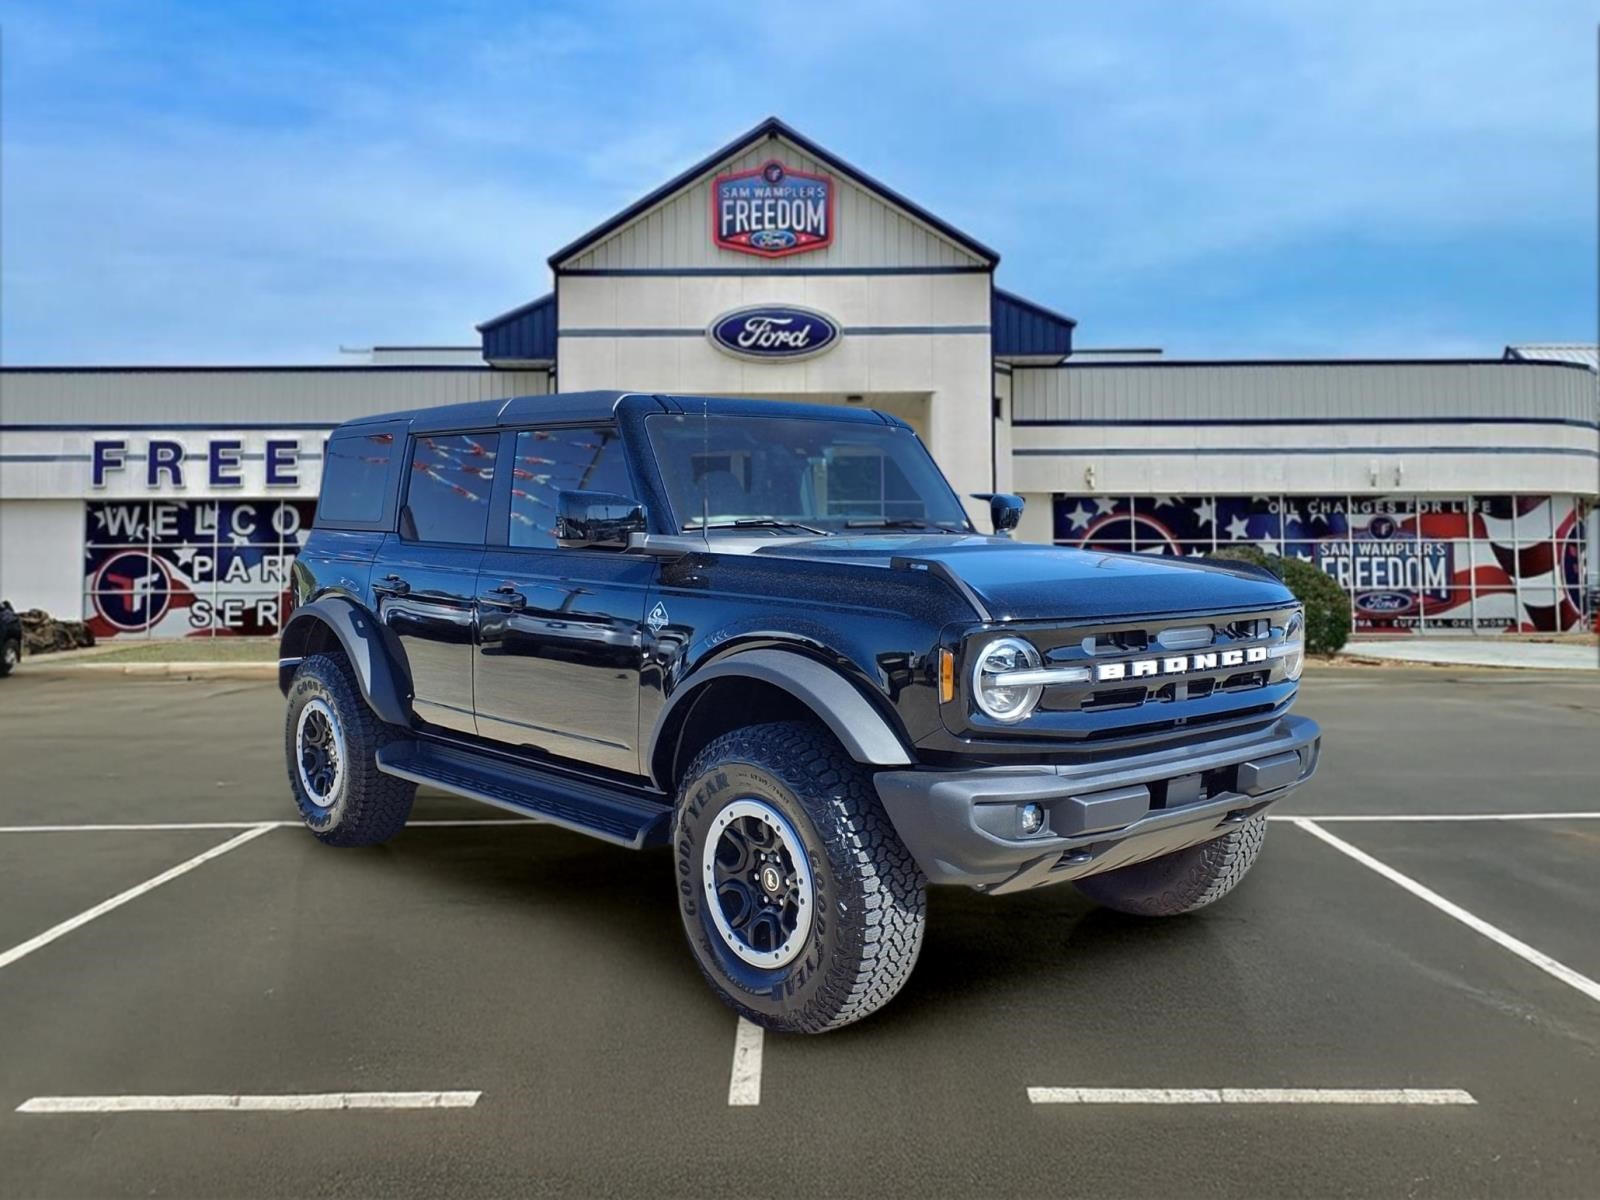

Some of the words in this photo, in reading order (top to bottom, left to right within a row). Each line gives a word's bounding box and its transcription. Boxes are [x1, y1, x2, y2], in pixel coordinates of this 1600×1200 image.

[722, 187, 750, 198] SAM
[722, 199, 825, 236] FREEDOM
[759, 233, 789, 248] Ford
[737, 316, 811, 347] Ford
[92, 440, 329, 487] FREE
[1268, 502, 1299, 514] OIL
[1307, 501, 1396, 514] CHANGES
[1405, 501, 1442, 514] FOR
[1451, 501, 1492, 513] LIFE
[1321, 557, 1447, 598] FREEDOM
[1366, 594, 1400, 609] Ford
[1097, 647, 1267, 680] BRONCO
